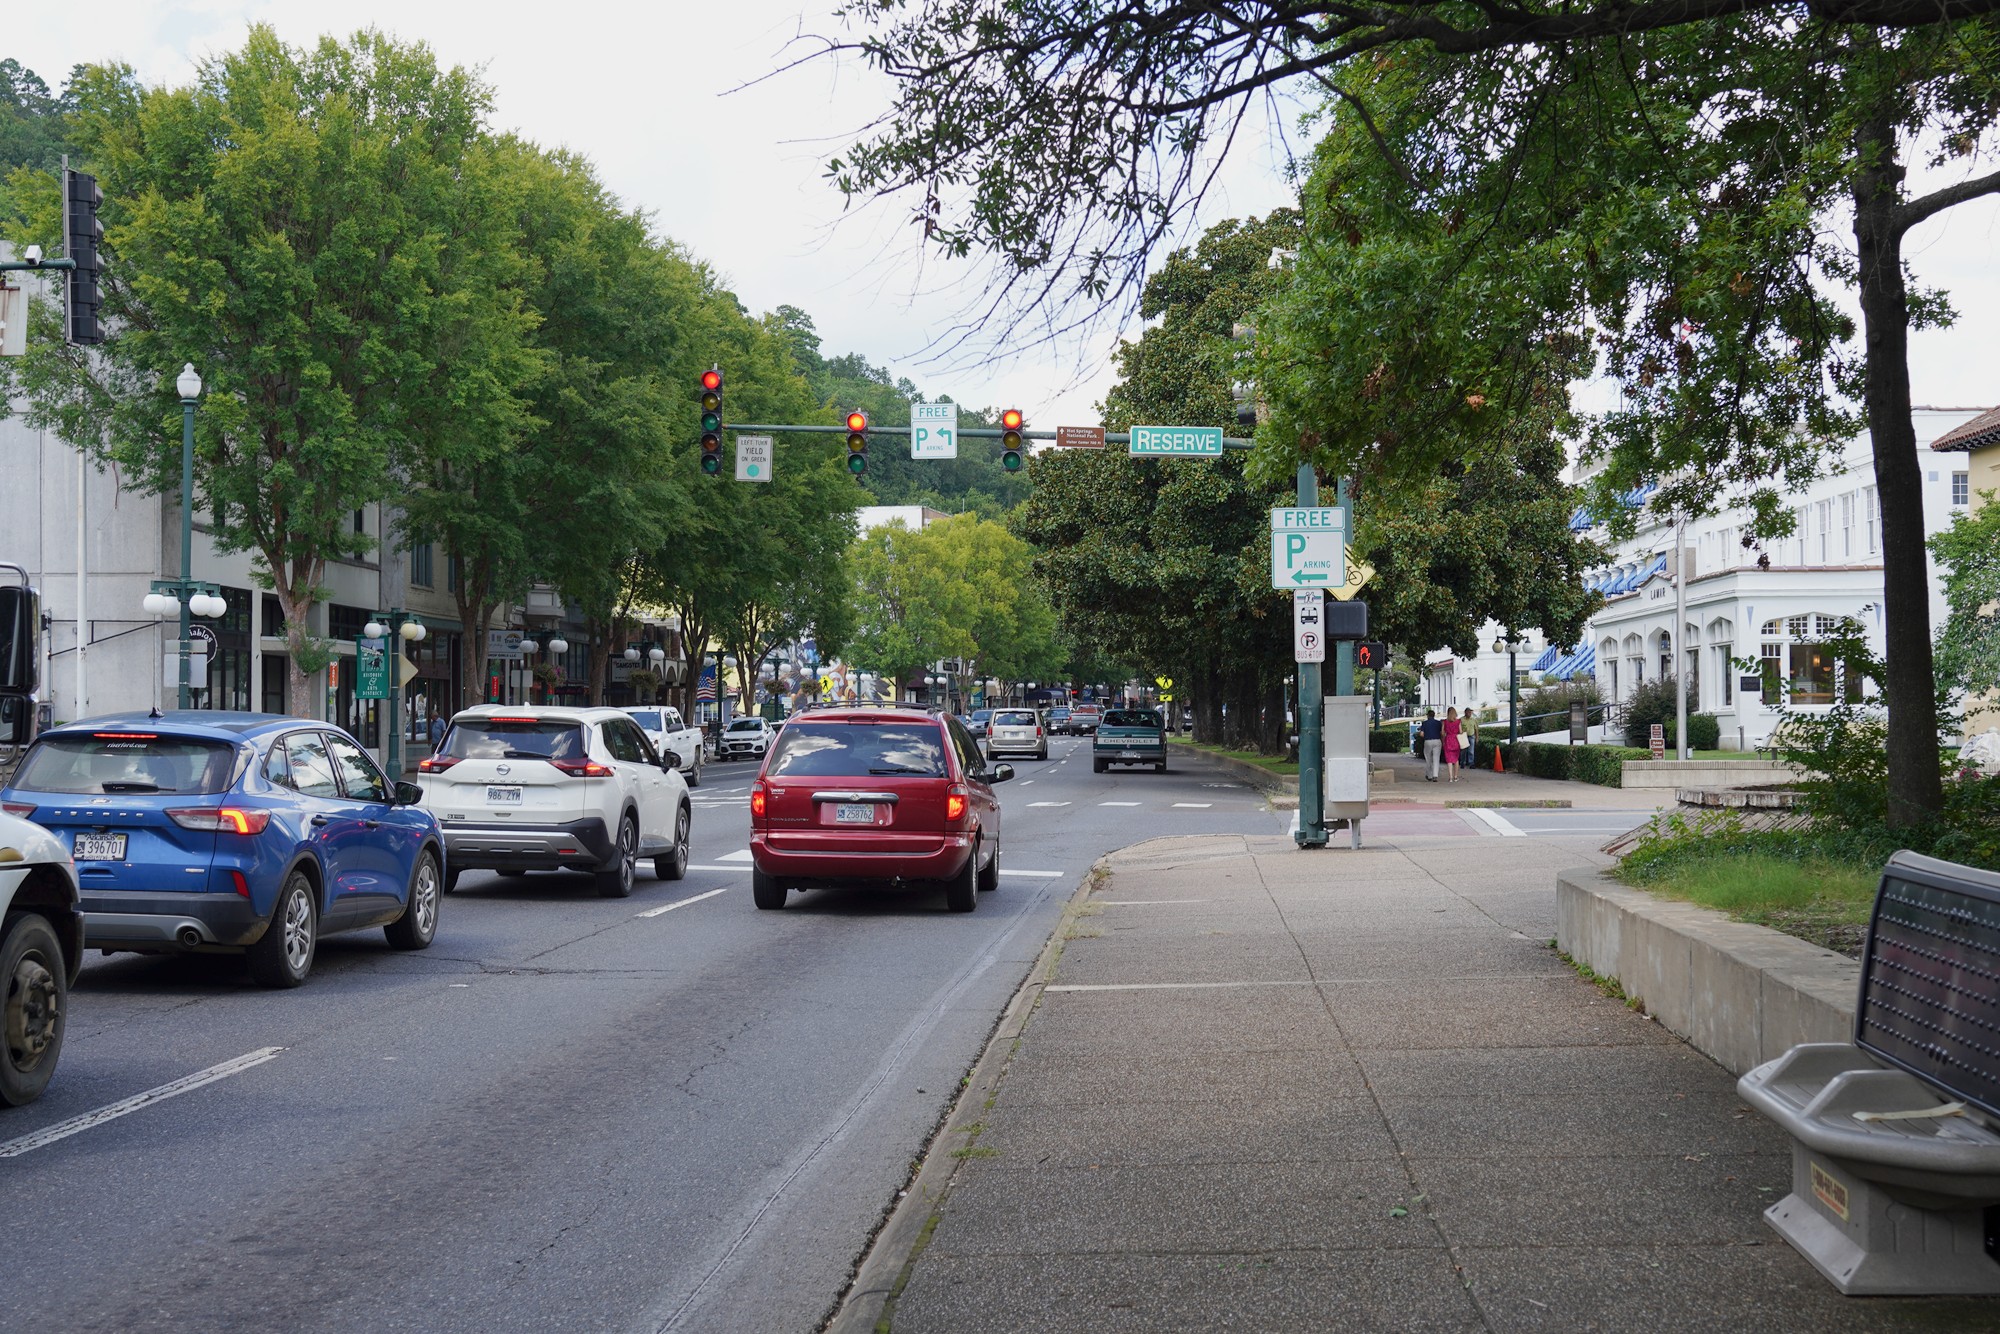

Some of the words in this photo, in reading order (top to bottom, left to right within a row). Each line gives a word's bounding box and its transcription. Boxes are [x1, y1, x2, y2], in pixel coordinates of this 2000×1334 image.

[918, 406, 948, 417] FREE
[1137, 430, 1216, 451] RESERVE
[745, 447, 764, 455] YIELD
[1284, 511, 1331, 527] FREE
[1297, 650, 1307, 659] BUS
[1309, 650, 1323, 659] STOP
[487, 791, 502, 801] 986
[846, 809, 873, 820] 258762
[87, 841, 122, 854] 396701
